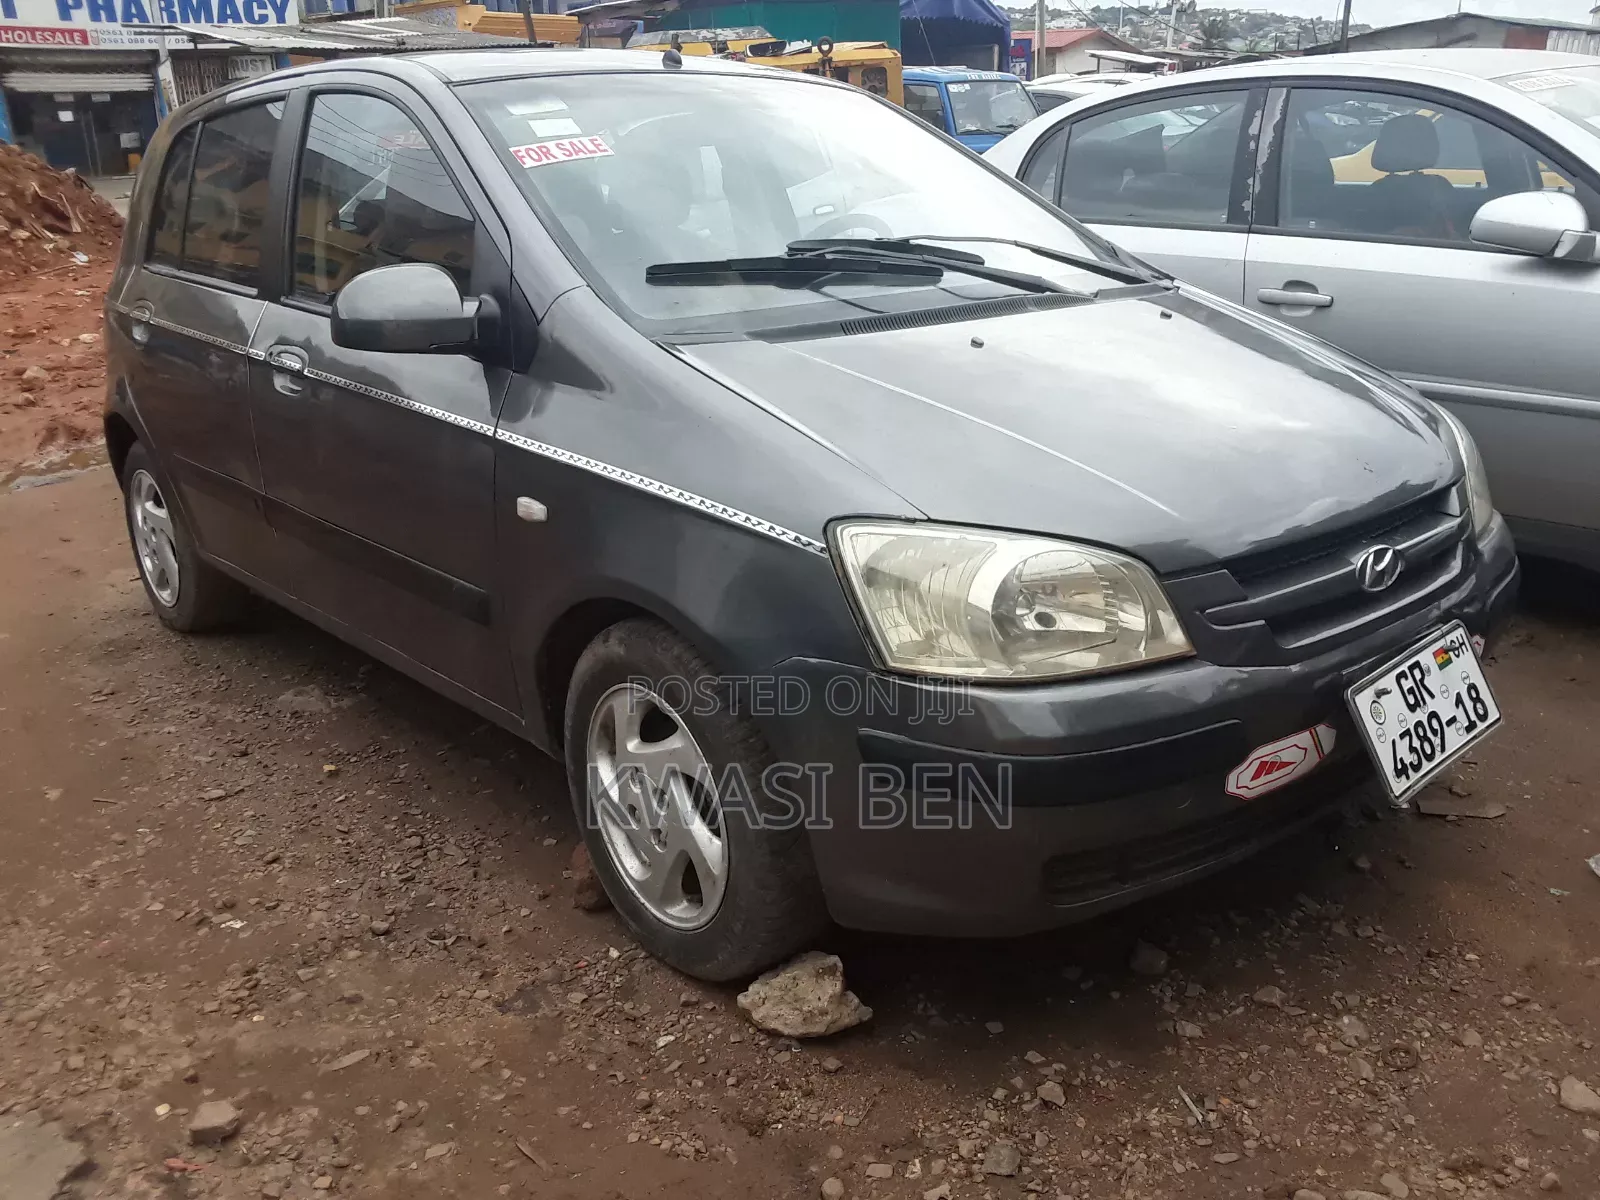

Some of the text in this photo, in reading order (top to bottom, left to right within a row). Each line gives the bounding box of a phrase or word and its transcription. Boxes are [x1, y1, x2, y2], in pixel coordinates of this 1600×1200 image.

[54, 0, 290, 25] PHARMACY
[0, 29, 84, 45] HOLESALE
[512, 138, 609, 165] FOR SALE
[1395, 660, 1436, 713] GR
[1392, 682, 1489, 781] 4389-18
